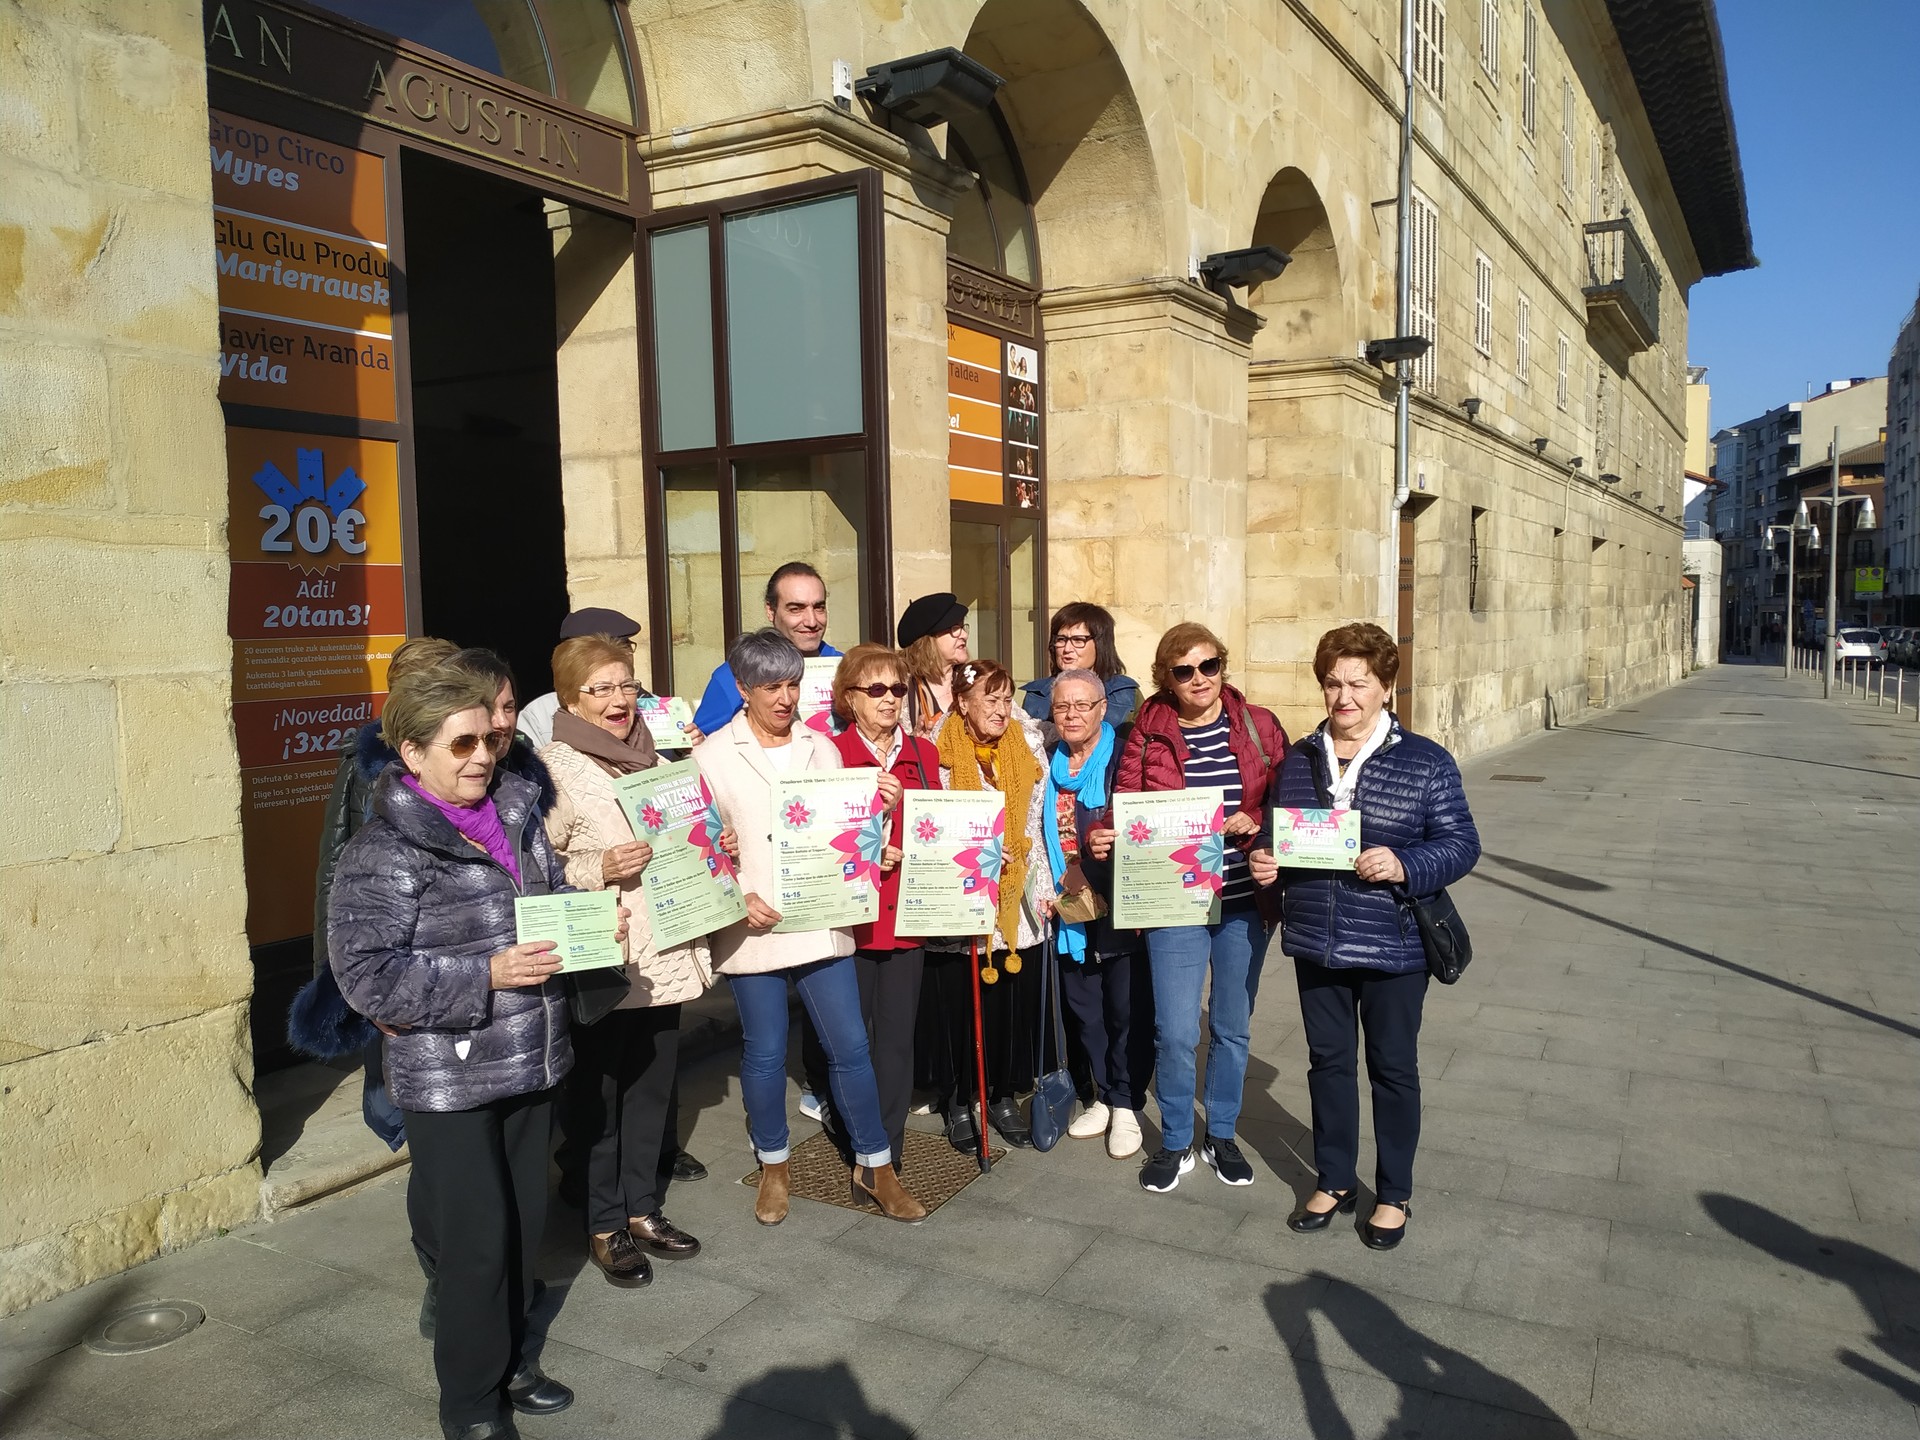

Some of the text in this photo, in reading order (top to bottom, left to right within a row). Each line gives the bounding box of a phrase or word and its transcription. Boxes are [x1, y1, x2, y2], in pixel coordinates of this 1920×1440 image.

[364, 60, 582, 172] AGUSTIN
[278, 136, 344, 175] Circo
[210, 146, 299, 191] Myres
[215, 219, 389, 279] Glu Glu Produ
[303, 335, 390, 370] Aranda
[220, 352, 288, 384] Vida
[949, 363, 979, 383] Taldea
[258, 504, 367, 554] 20€
[296, 580, 337, 599] Adi!
[263, 605, 371, 628] 20tan3!
[291, 654, 326, 664] gozatzeko
[353, 653, 374, 661] izango
[307, 667, 351, 678] gustukoenak
[274, 702, 372, 730] ¡Novedad!
[252, 775, 282, 784] Disfruta
[253, 791, 271, 799] Elige
[254, 799, 288, 809] interesen
[296, 794, 319, 804] pásate
[651, 783, 702, 811] ANTZERKI
[668, 798, 707, 818] FESTIBALA
[1146, 810, 1211, 828] ANTZERKI
[1162, 825, 1211, 837] FESTIBALA
[655, 898, 674, 909] 14-15
